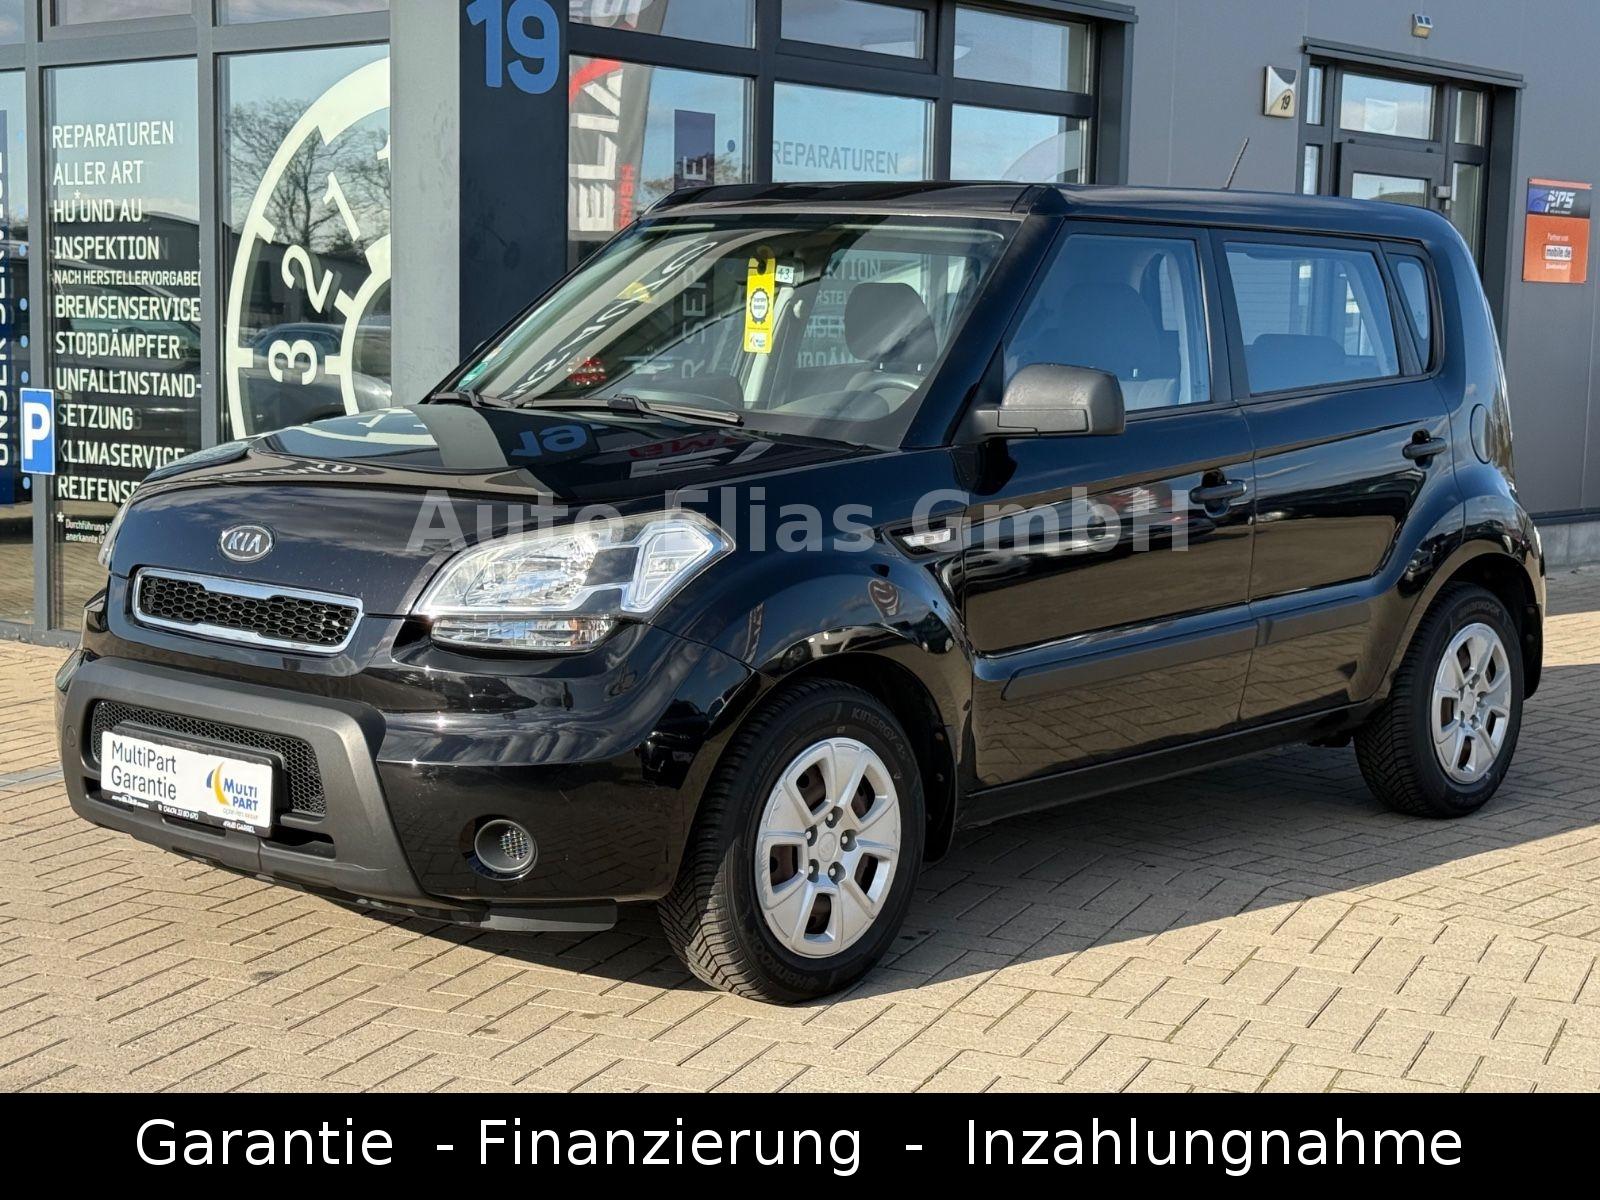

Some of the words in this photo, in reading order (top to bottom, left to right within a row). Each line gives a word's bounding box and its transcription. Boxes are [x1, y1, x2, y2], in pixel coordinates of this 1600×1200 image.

[466, 0, 560, 94] 19
[1280, 95, 1291, 111] 19
[52, 120, 174, 149] REPARATUREN
[772, 140, 898, 174] REPARATUREN
[53, 162, 106, 186] ALLER
[110, 160, 144, 184] ART
[80, 199, 115, 223] UND
[119, 198, 142, 222] AU
[53, 236, 160, 260] INSPEKTION
[53, 270, 82, 285] NACH
[55, 295, 201, 321] BREMSENSERVICE
[55, 329, 181, 359] STOßDÄMPFER
[56, 367, 202, 398] UNFALLINSTAND-
[57, 404, 134, 430] SETZUNG
[23, 402, 50, 460] P
[58, 439, 185, 471] KLIMASERVICE
[227, 531, 262, 554] KIA
[112, 740, 176, 774] MultiPart
[111, 765, 177, 801] Garantie
[232, 795, 259, 812] PART
